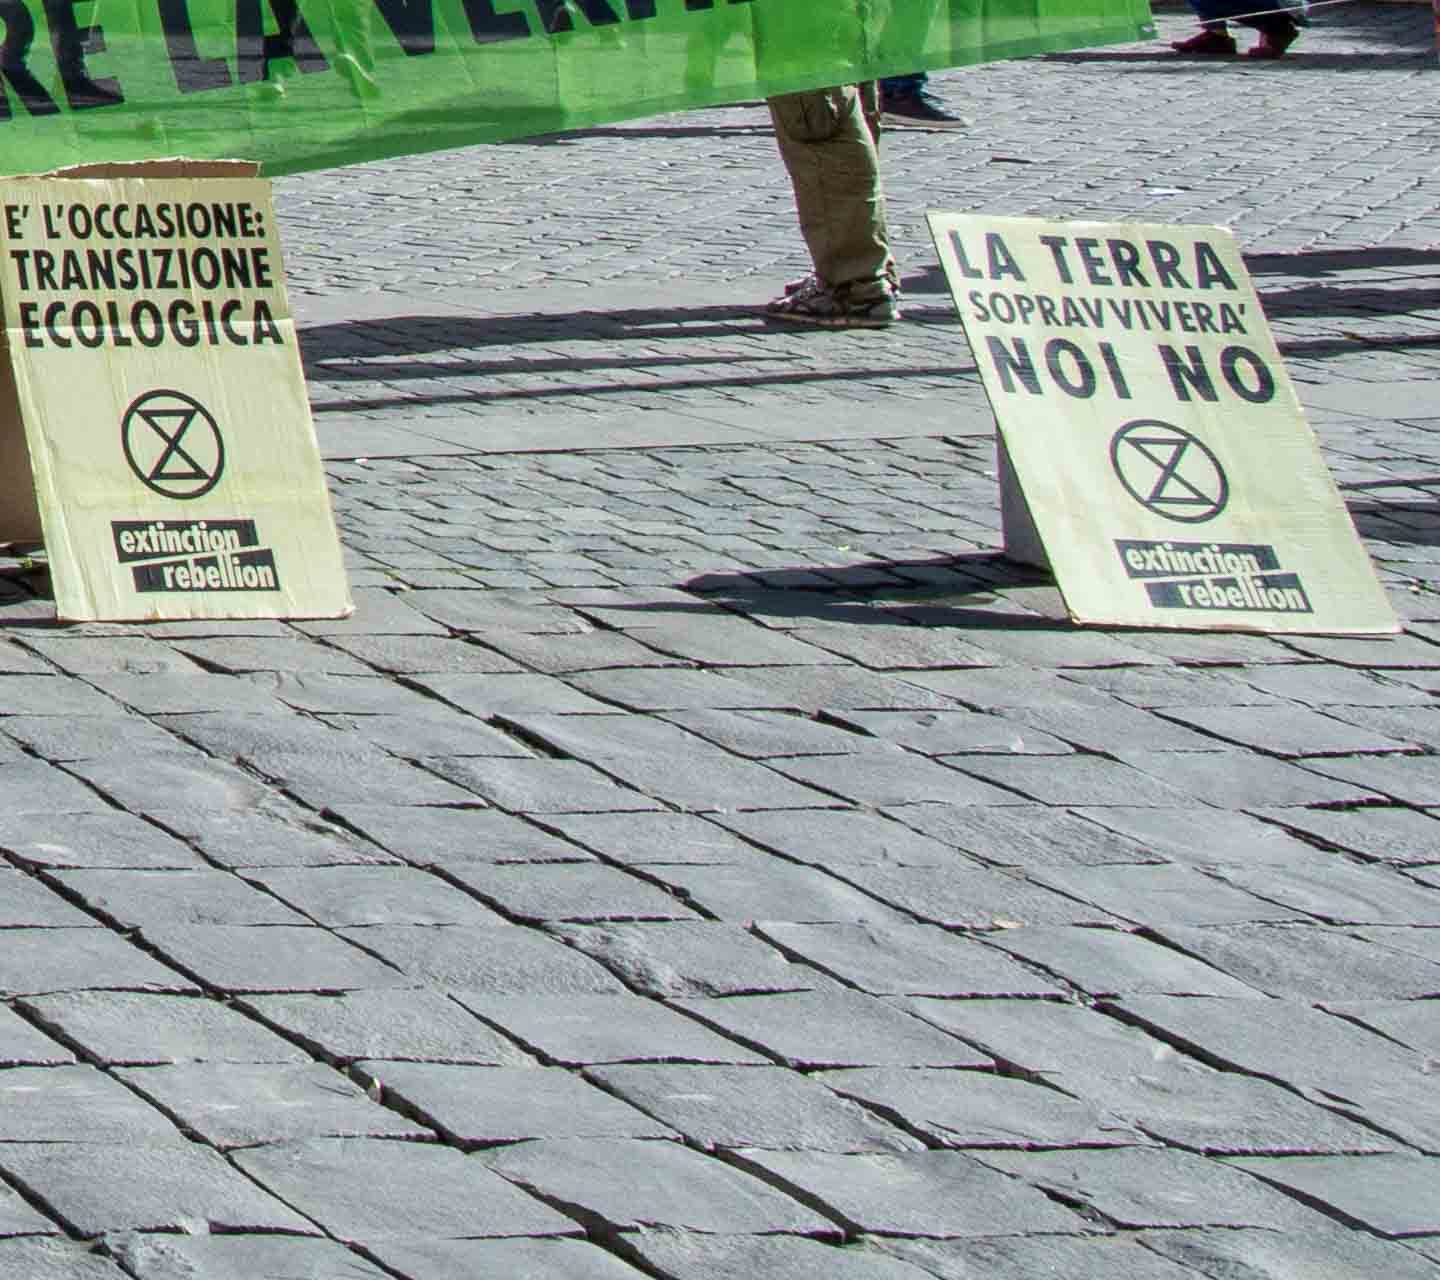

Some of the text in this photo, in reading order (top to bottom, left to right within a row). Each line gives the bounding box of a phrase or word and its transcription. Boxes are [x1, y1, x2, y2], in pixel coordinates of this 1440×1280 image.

[42, 202, 266, 240] L'OCCASIONE:
[9, 247, 274, 291] TRANSIZIONE
[947, 229, 1241, 291] LA TERRA
[18, 299, 285, 349] ECOLOGICA
[984, 335, 1276, 404] NOI NO
[119, 521, 240, 553] extinction
[162, 551, 276, 589] rebellion
[1125, 543, 1263, 576] extinction
[1176, 574, 1308, 611] rebellion
